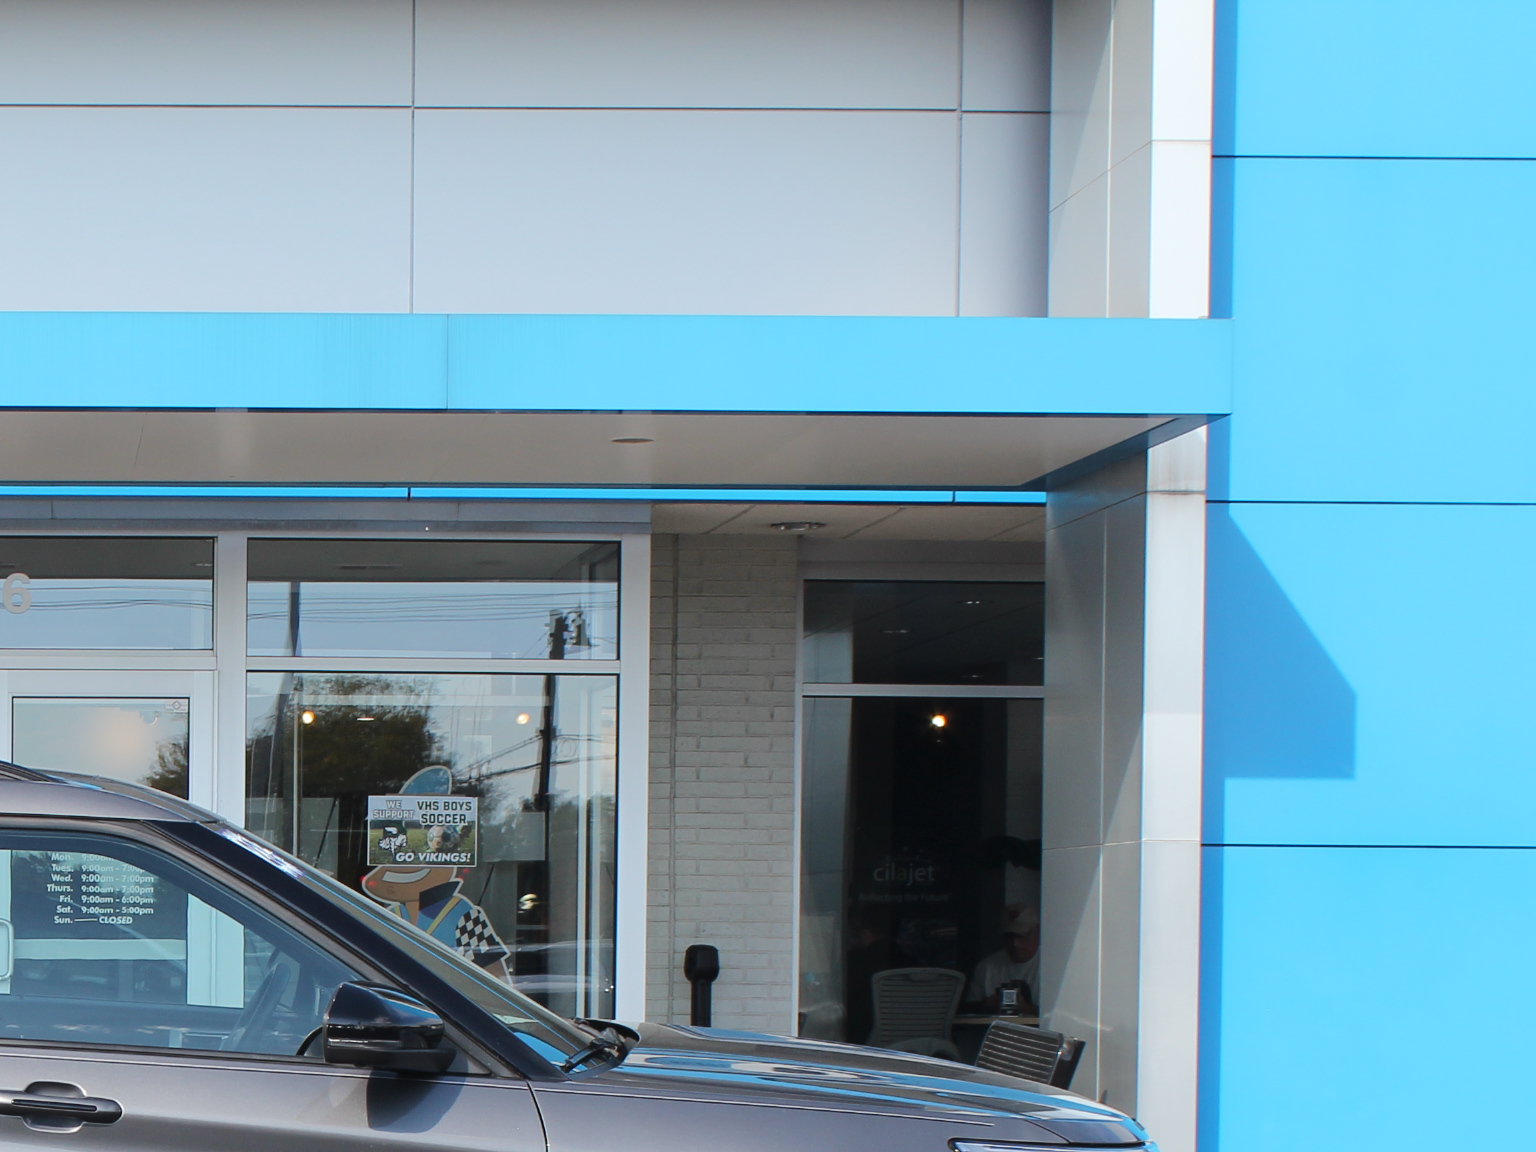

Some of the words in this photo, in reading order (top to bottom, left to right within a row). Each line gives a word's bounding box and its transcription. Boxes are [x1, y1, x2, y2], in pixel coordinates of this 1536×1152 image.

[386, 799, 403, 809] WE
[417, 801, 439, 811] VHS
[443, 801, 472, 811] BOYS
[372, 809, 414, 819] SUPPORT
[420, 813, 467, 824] SOCCER
[395, 853, 415, 862] GO
[418, 853, 471, 863] VIKINGS!
[51, 863, 73, 872] Tues.
[81, 864, 113, 872] 9:00am
[51, 873, 73, 882] Wed.
[81, 873, 113, 882] 9:00am
[122, 874, 154, 884] 7:00pm
[872, 863, 935, 886] cilajet
[47, 883, 73, 892] Thurs.
[81, 885, 113, 893] 9:00am
[122, 885, 154, 895] 7:00pm
[59, 895, 73, 903] Fri.
[81, 895, 113, 903] 9:00am
[122, 895, 154, 905] 6:00pm
[56, 905, 73, 913] Sat.
[81, 906, 113, 914] 9:00am
[122, 906, 154, 915] 5:00pm
[54, 916, 73, 924] Sun.
[99, 916, 133, 924] CLOSED
